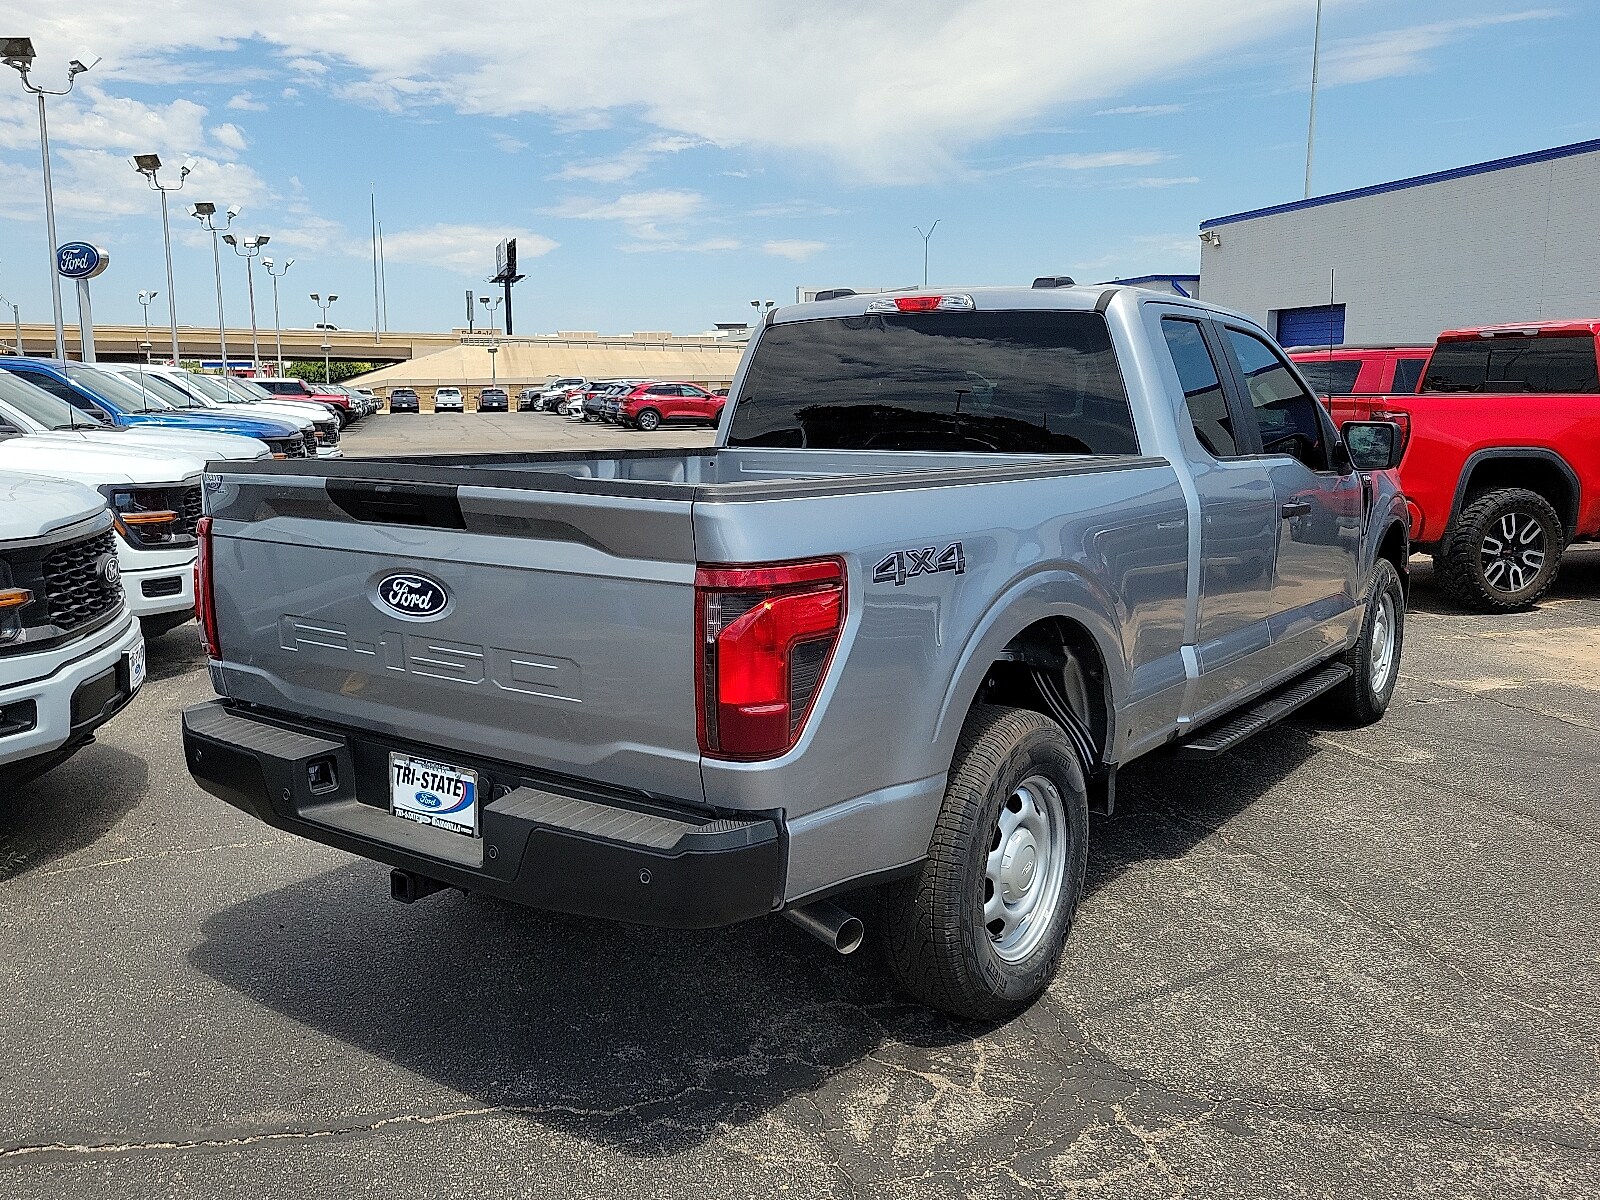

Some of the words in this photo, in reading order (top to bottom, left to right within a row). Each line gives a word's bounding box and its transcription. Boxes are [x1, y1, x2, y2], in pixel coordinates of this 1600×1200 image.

[60, 248, 89, 271] Ford
[388, 578, 433, 610] Ford
[277, 611, 583, 704] F-150
[393, 763, 463, 798] TRI-STATE
[419, 793, 437, 806] Ford
